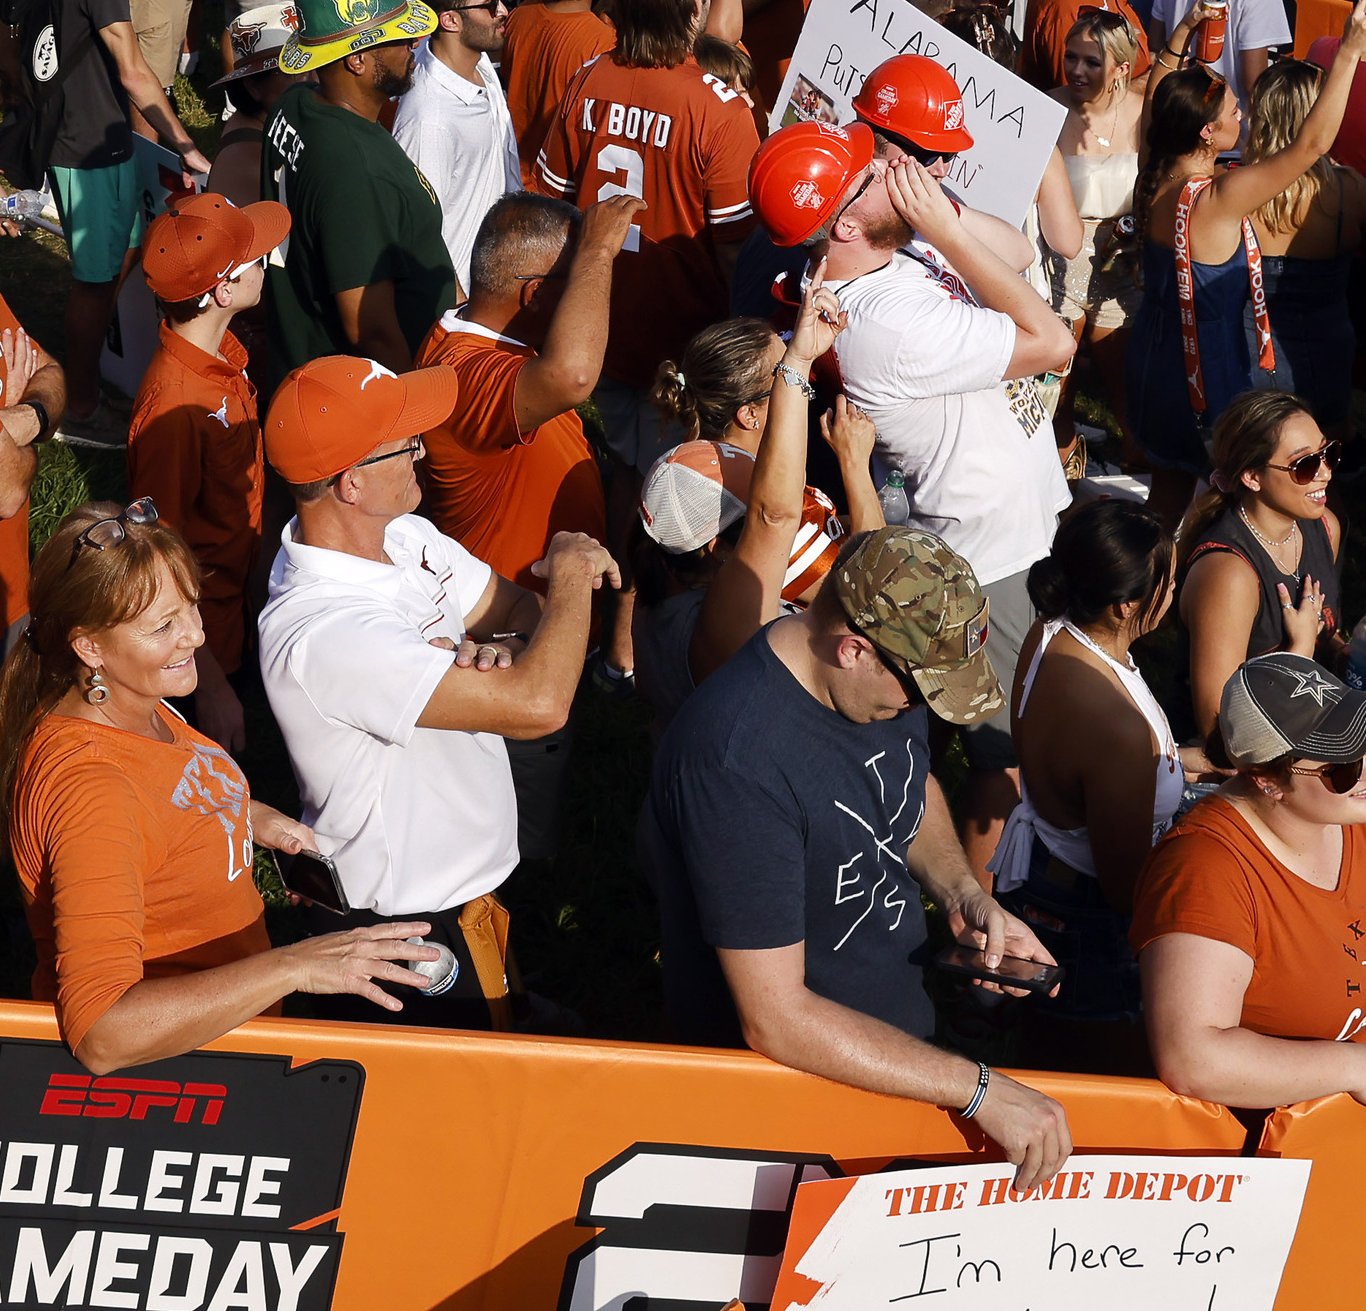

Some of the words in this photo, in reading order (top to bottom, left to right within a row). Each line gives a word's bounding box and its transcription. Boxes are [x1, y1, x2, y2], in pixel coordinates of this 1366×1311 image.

[582, 97, 596, 133] K.
[607, 102, 672, 148] BOYD
[1174, 202, 1188, 263] HOOK
[1242, 221, 1259, 259] 'EM
[1176, 266, 1191, 301] 'EM
[1250, 260, 1268, 318] HOOK
[38, 1072, 228, 1126] ESPN
[884, 1179, 968, 1217] THE
[1104, 1170, 1244, 1206] DEPOT
[889, 1232, 1003, 1302] I'm
[1048, 1228, 1144, 1271] here
[1173, 1221, 1235, 1267] for
